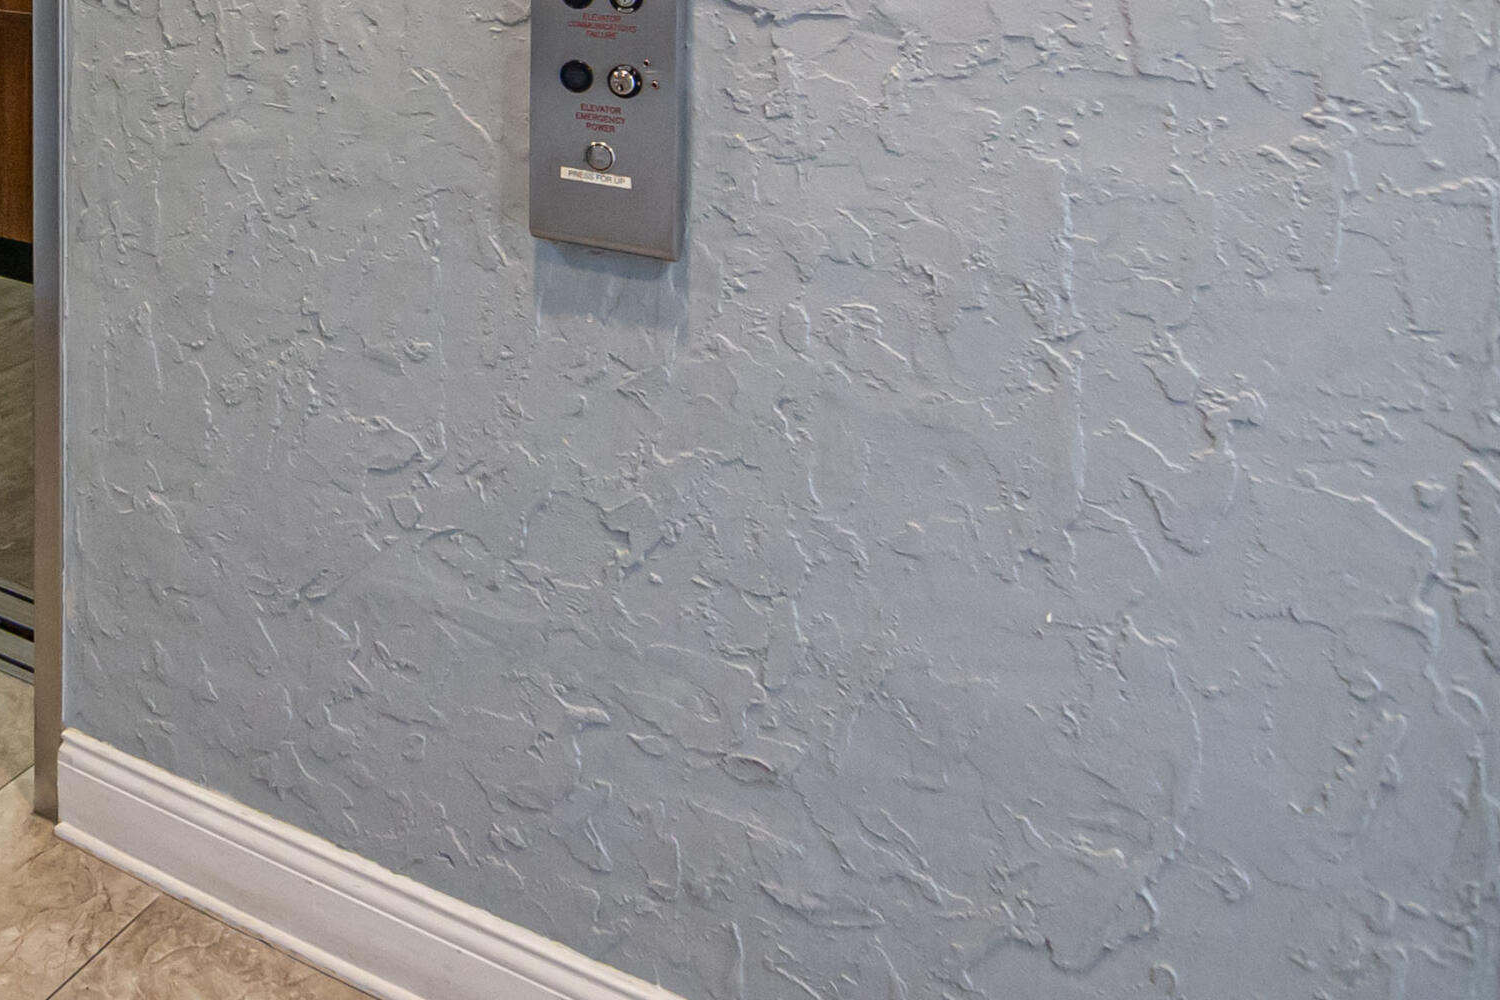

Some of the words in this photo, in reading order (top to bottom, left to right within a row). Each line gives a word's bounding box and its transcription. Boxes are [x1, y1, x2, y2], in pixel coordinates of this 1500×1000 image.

[581, 102, 622, 114] ELEVATOR
[575, 112, 626, 125] EMERGENCY
[586, 122, 616, 133] POWER
[568, 169, 594, 180] PRESS
[595, 173, 613, 183] FOR
[614, 176, 626, 185] UP
